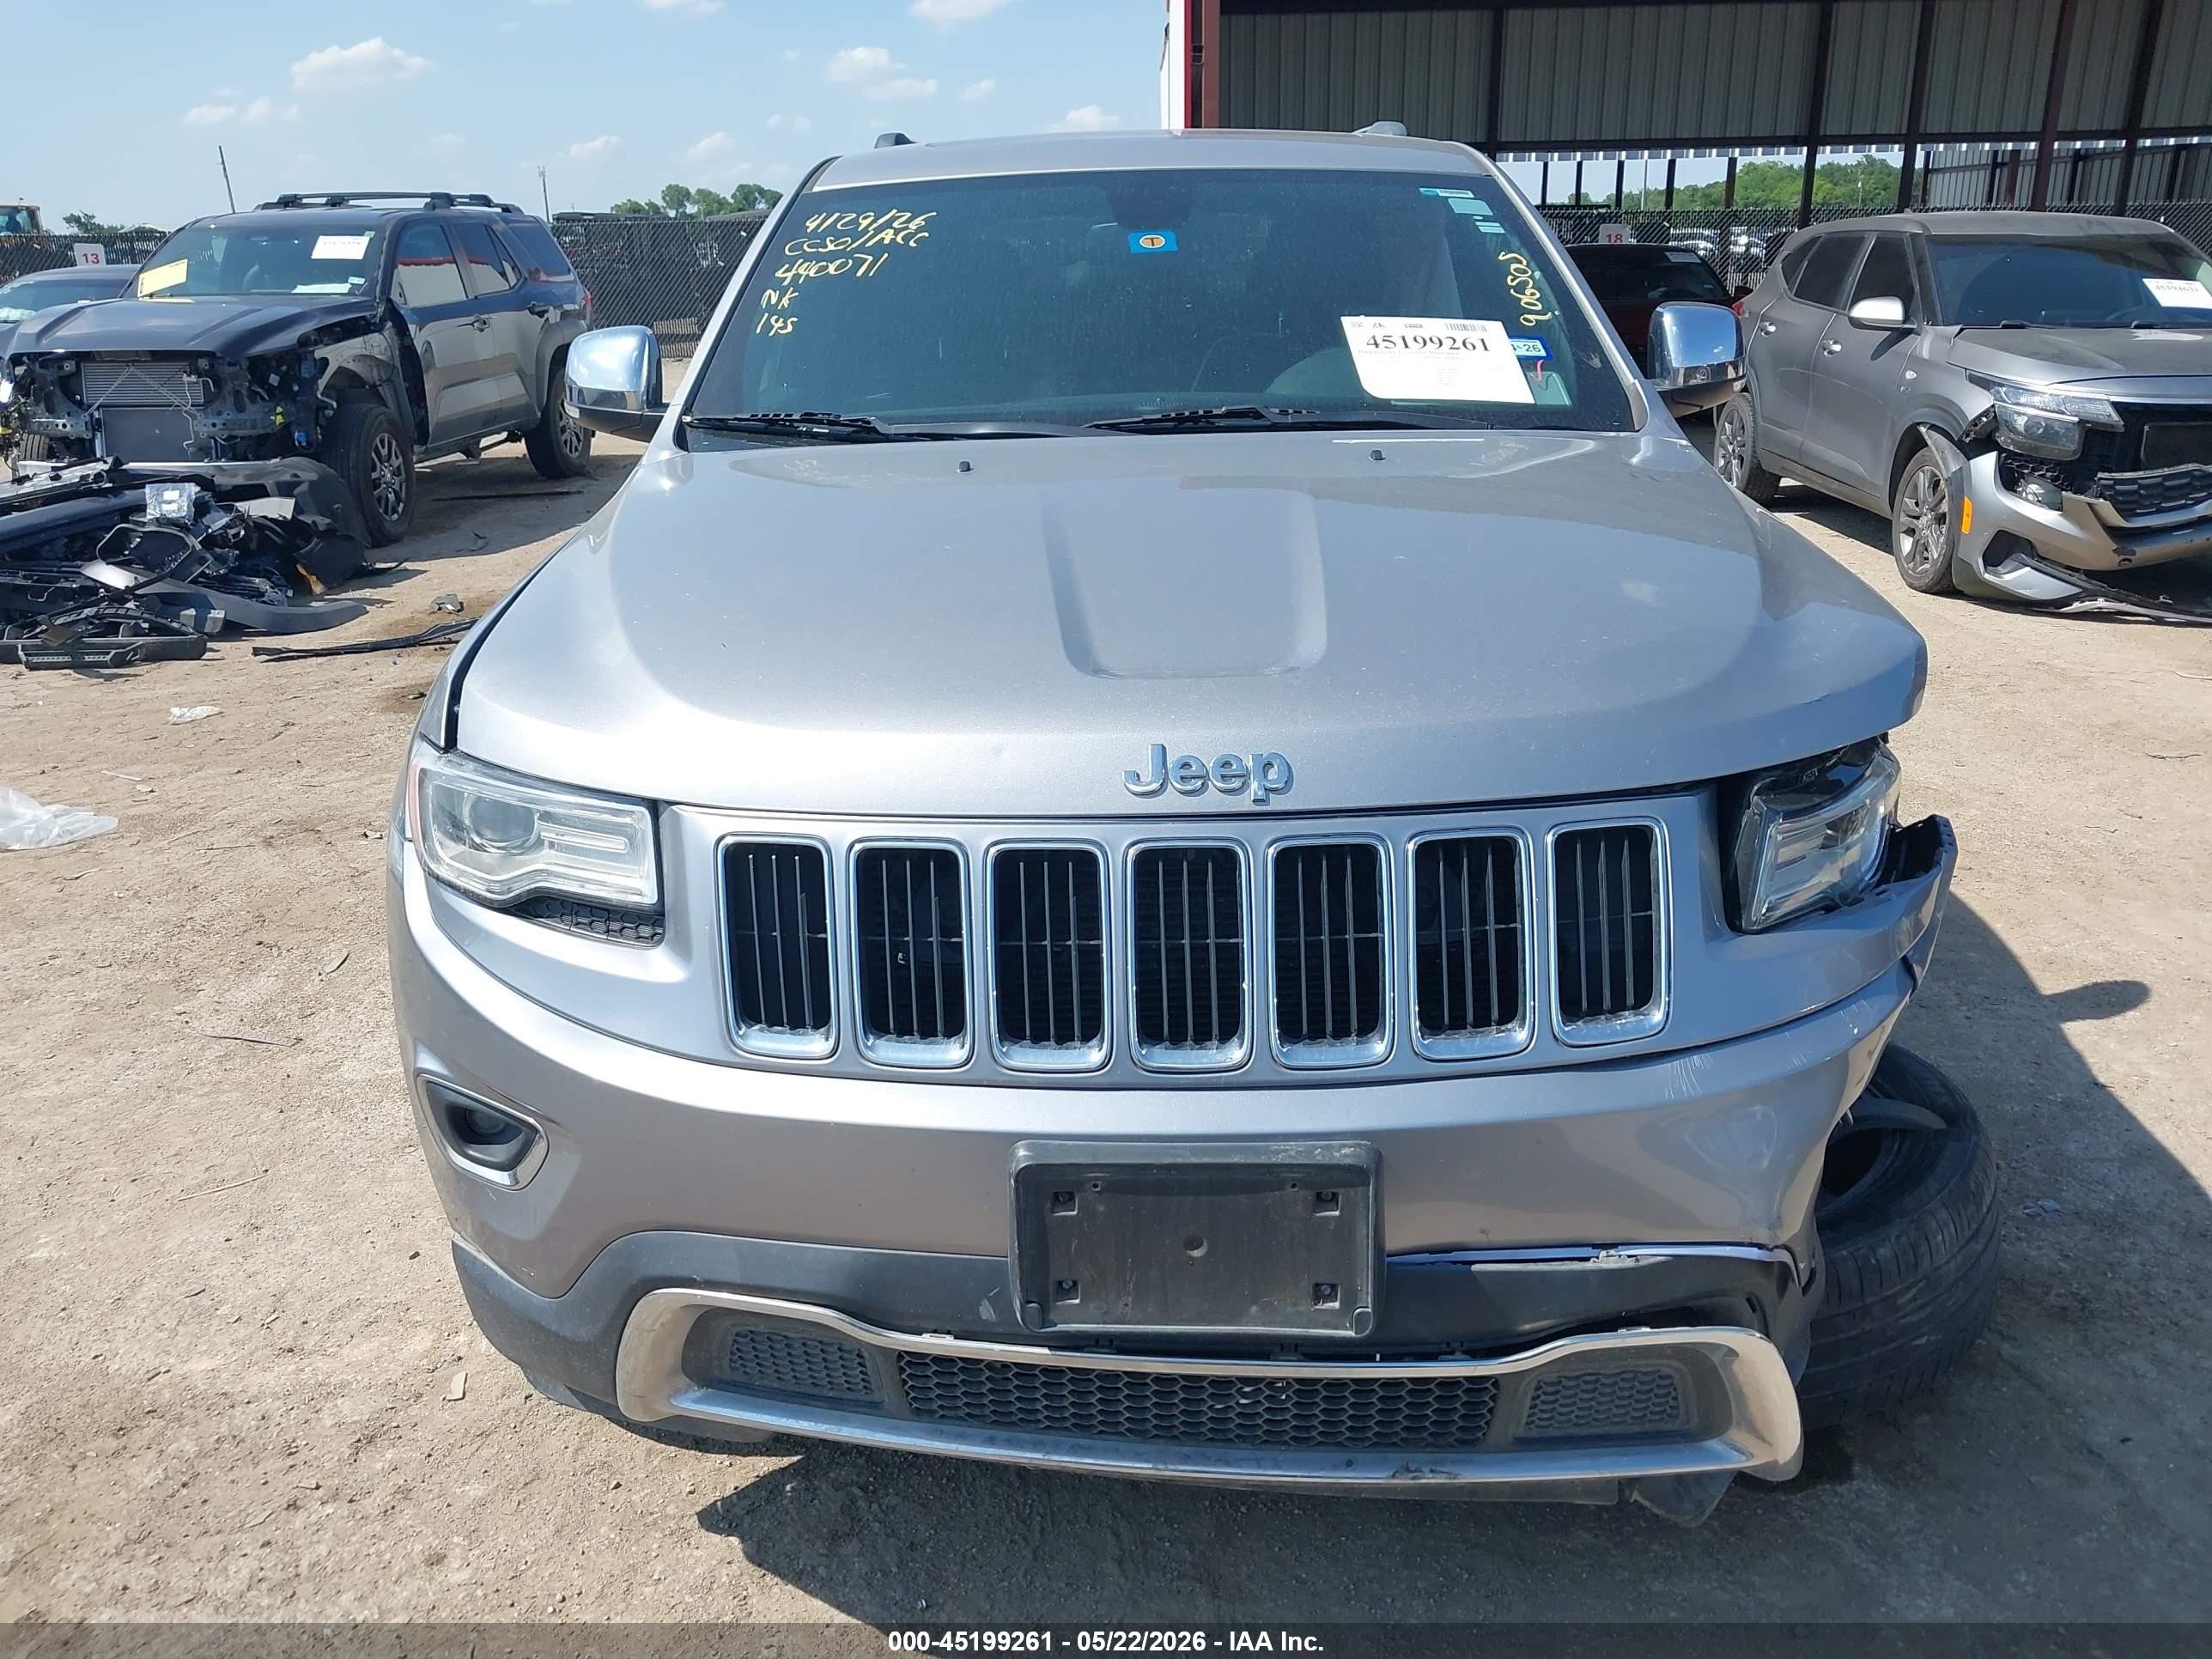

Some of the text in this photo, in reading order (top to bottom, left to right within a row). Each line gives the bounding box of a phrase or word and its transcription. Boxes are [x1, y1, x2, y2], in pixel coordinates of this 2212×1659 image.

[805, 209, 937, 234] 4/29/26
[1606, 234, 1623, 243] 18
[82, 253, 100, 264] 13
[775, 252, 889, 286] 440071
[1366, 334, 1491, 353] 45199261
[1122, 743, 1294, 806] Jeep
